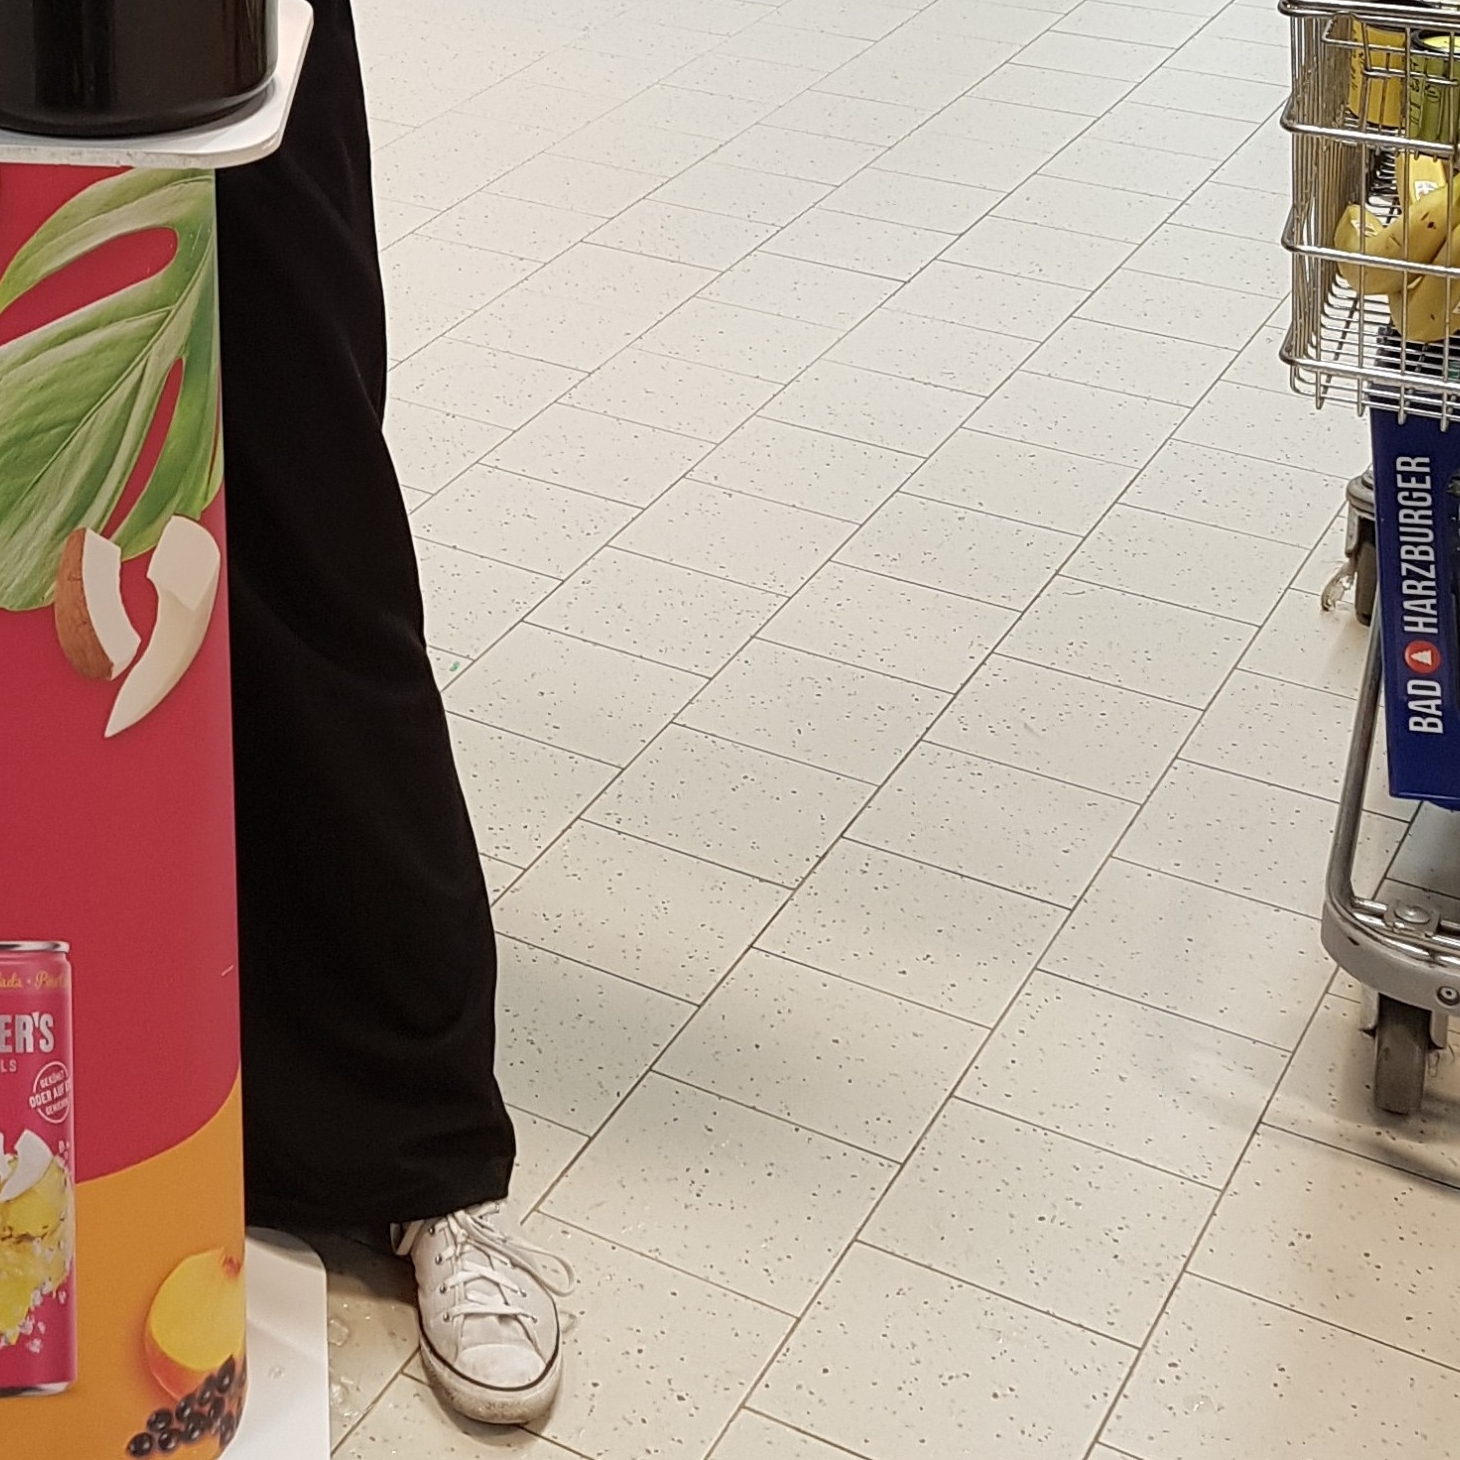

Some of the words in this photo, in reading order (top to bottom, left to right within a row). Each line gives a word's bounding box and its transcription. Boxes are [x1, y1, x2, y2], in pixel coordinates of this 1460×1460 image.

[1396, 456, 1438, 634] HARZBURGER
[1407, 679, 1444, 735] BAD
[29, 1090, 52, 1109] ODER
